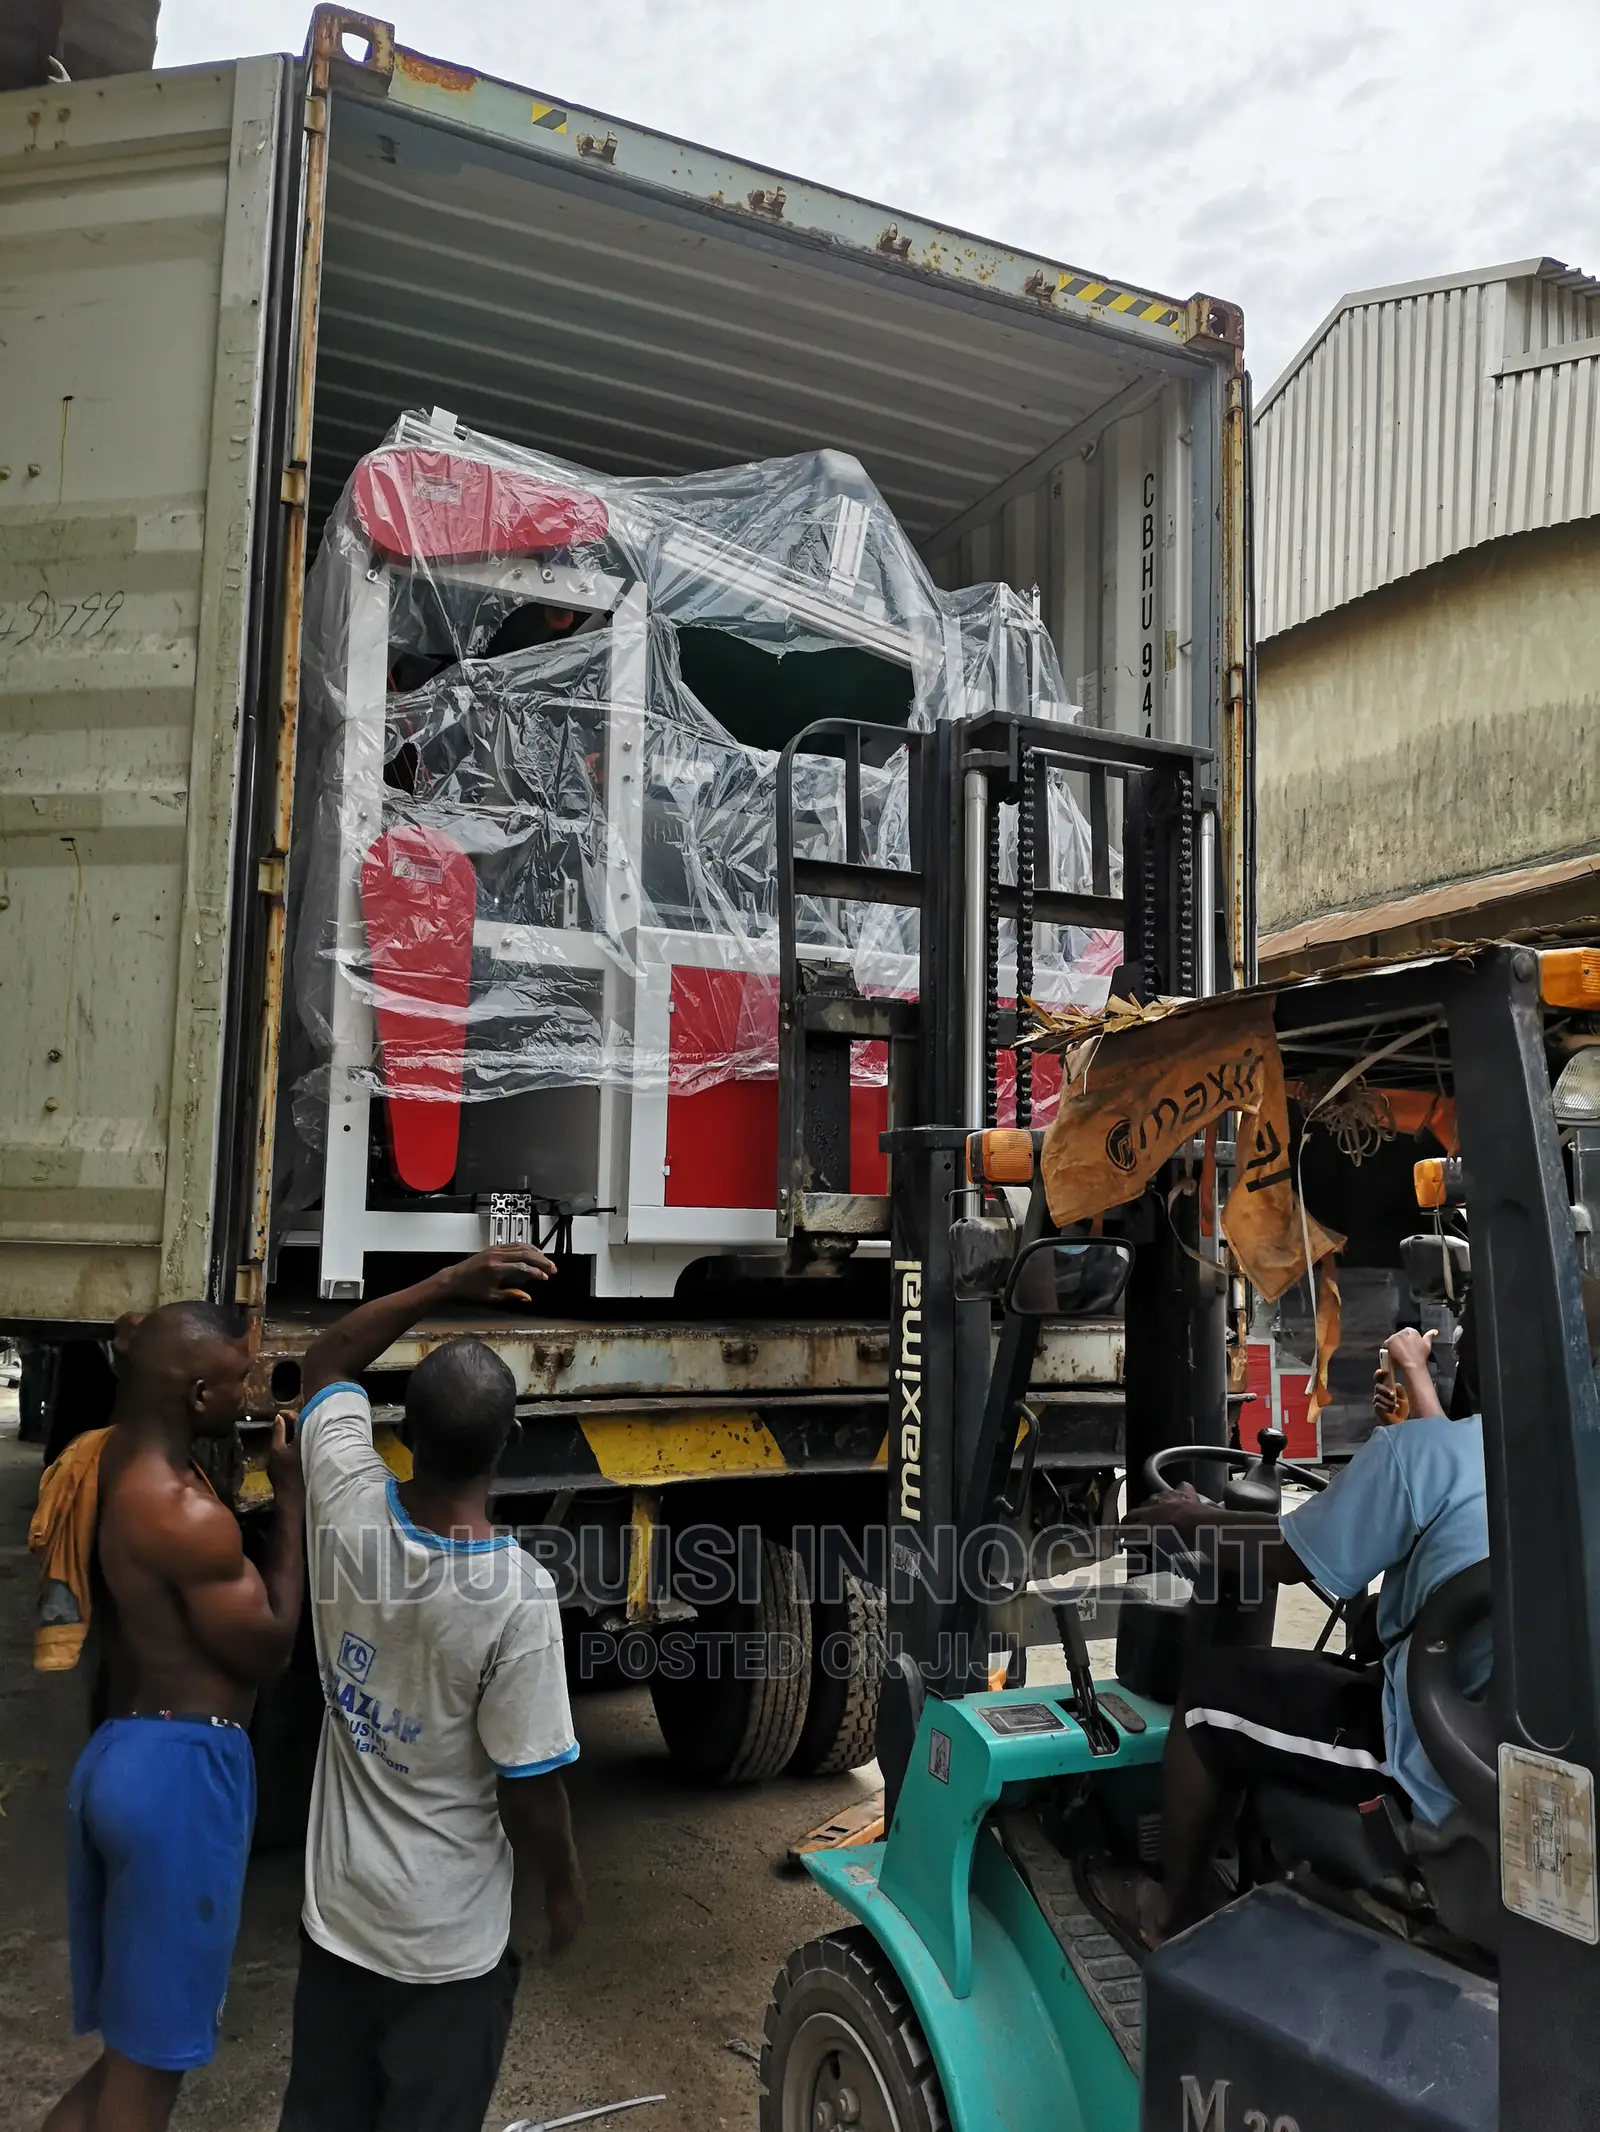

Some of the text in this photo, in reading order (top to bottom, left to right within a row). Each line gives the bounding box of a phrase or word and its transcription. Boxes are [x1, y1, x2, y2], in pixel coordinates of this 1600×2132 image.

[1141, 472, 1154, 631] CBHU
[894, 1260, 922, 1522] maximal
[1180, 2075, 1231, 2132] M
